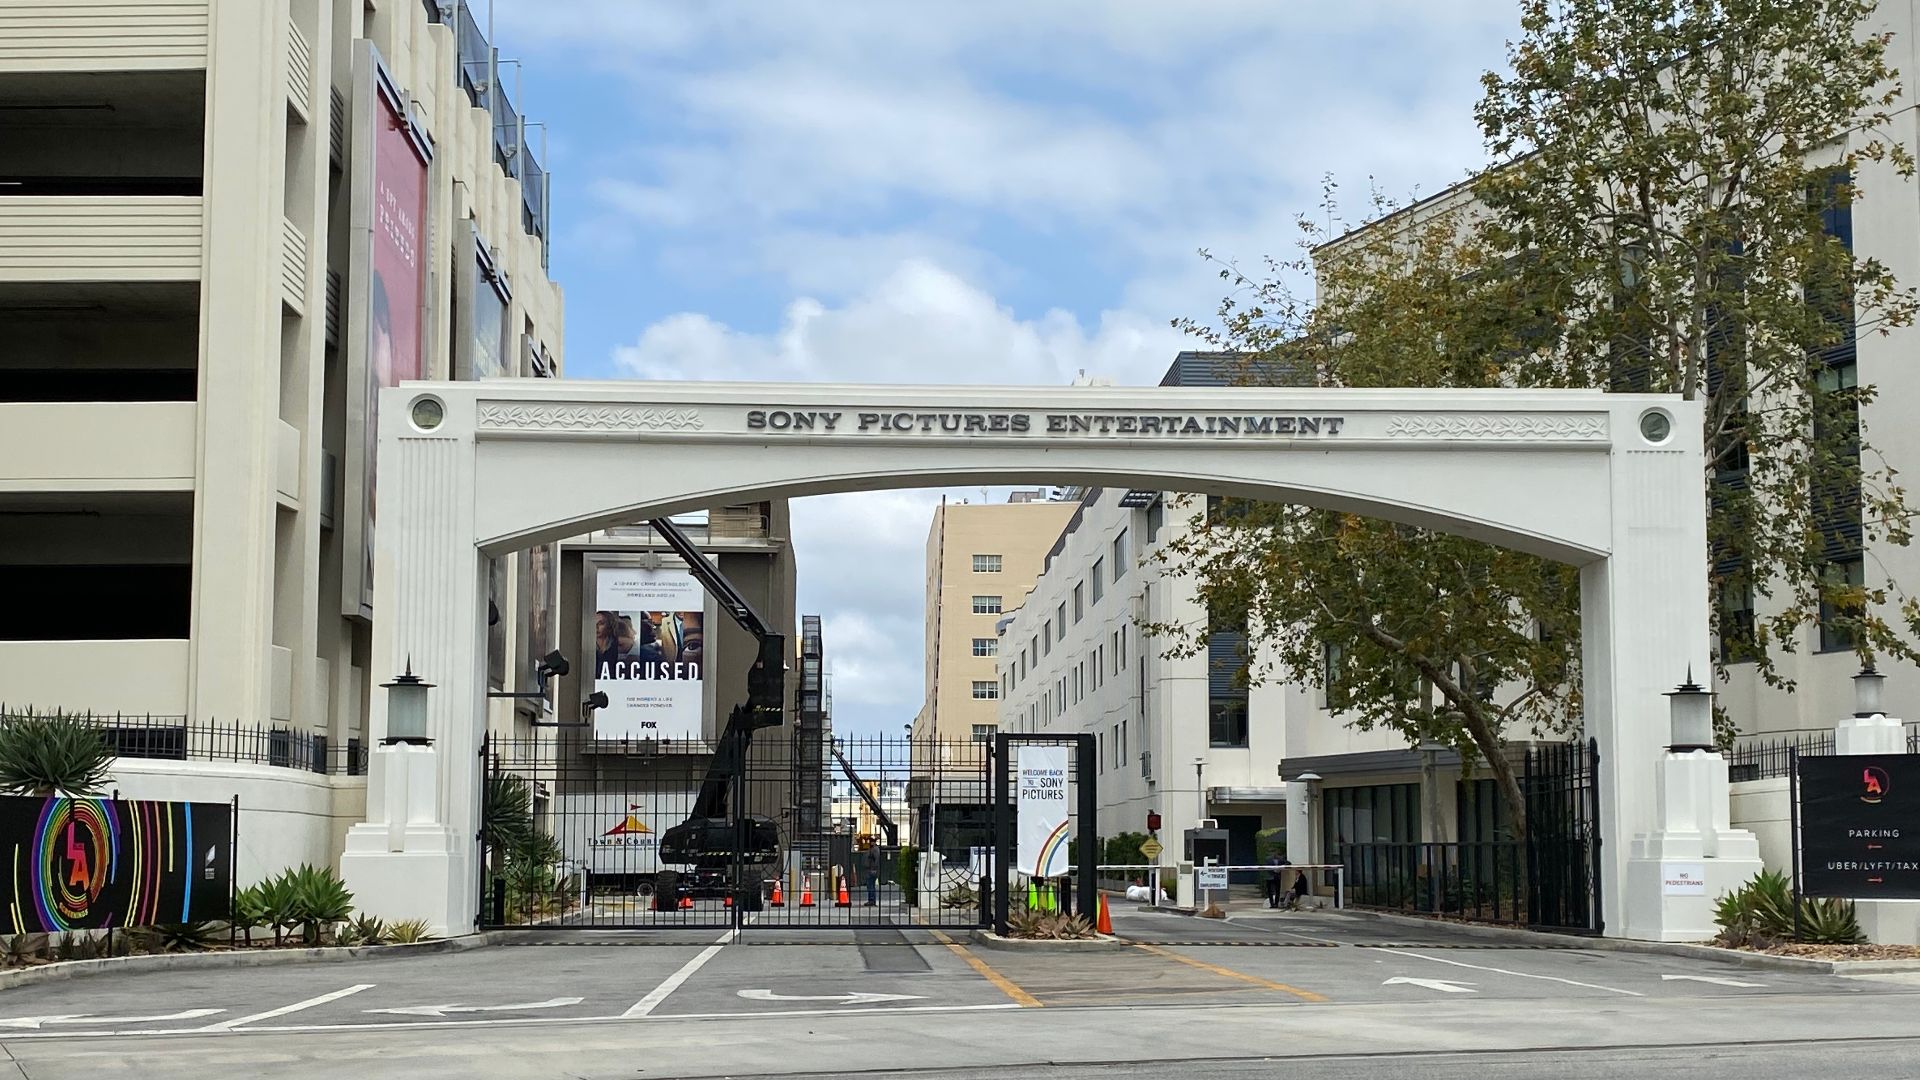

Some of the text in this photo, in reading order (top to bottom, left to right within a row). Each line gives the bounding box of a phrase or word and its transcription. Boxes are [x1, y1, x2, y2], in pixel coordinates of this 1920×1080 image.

[747, 410, 1345, 434] SONY PICTURES ENTERTAINMENT
[600, 661, 699, 681] ACCUSED
[641, 721, 657, 729] FOX
[1040, 777, 1064, 788] SONY
[1022, 789, 1064, 800] PICTURES
[1848, 829, 1900, 838] PARKING
